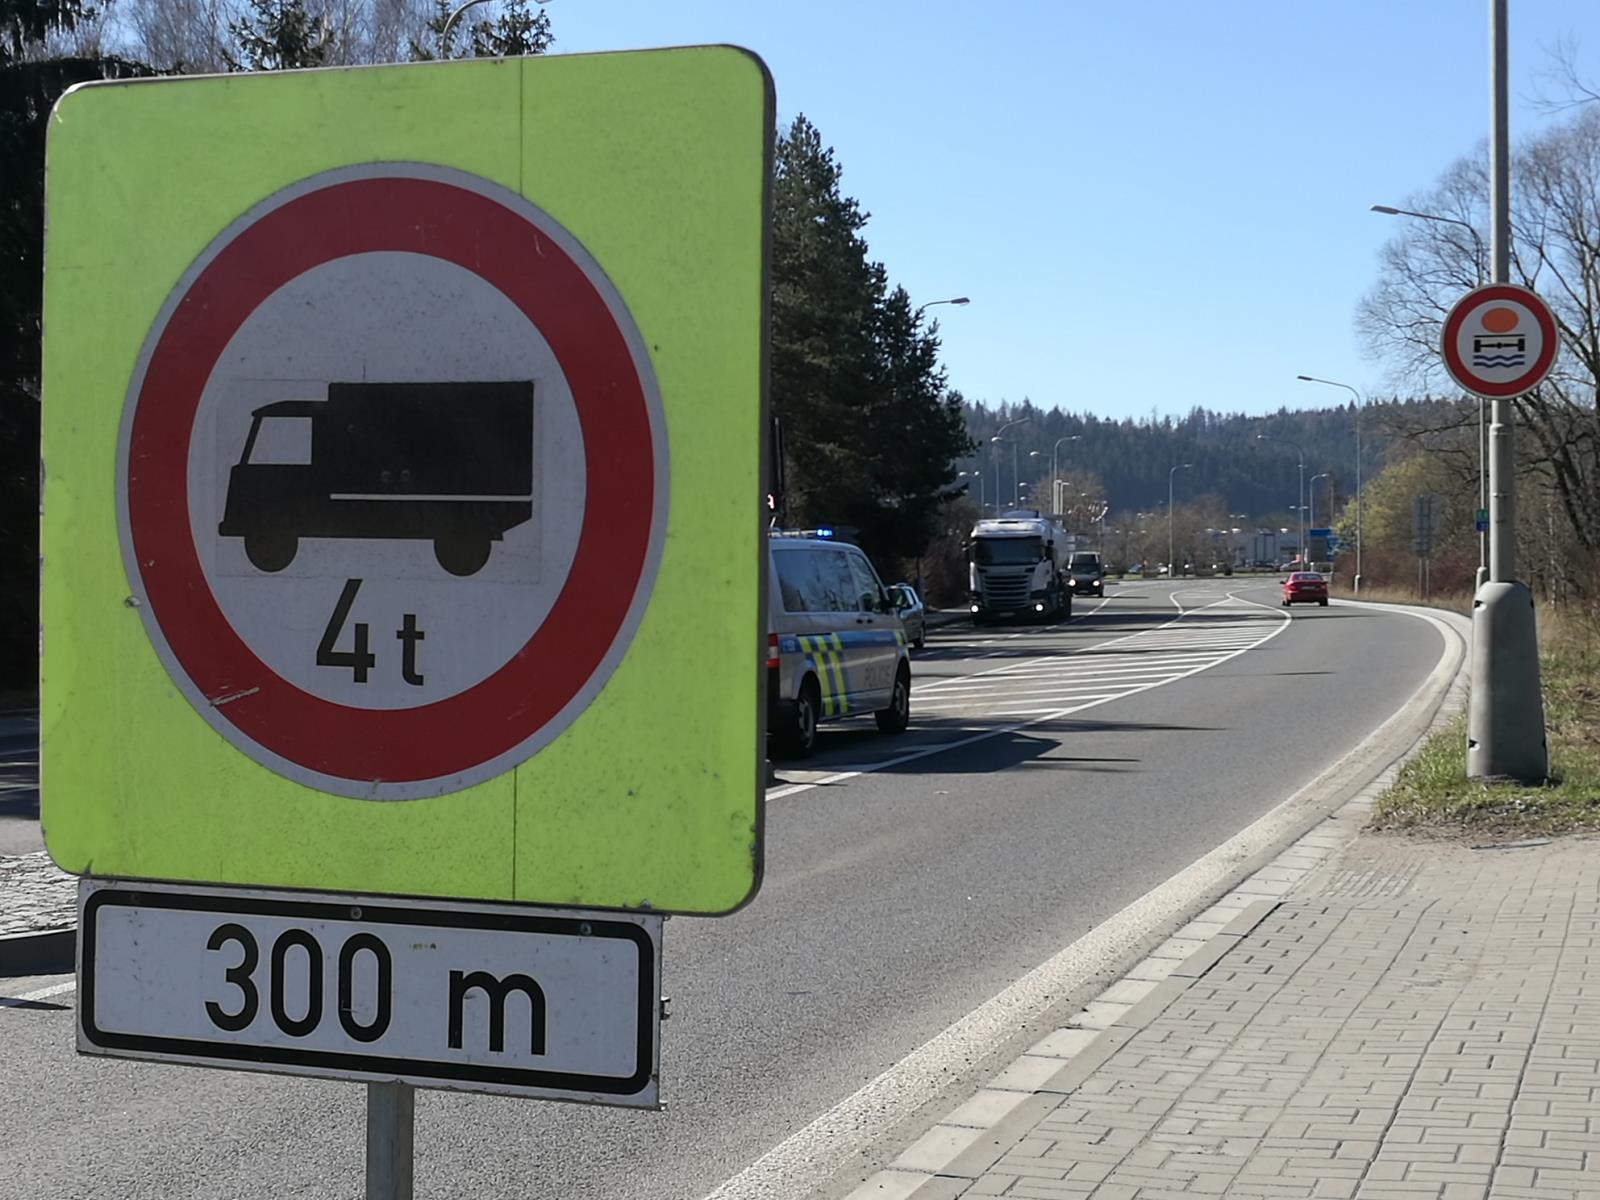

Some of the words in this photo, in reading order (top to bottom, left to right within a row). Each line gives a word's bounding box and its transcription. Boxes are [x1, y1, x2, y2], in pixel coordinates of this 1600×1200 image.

[316, 578, 376, 683] 4
[396, 614, 425, 686] t
[205, 923, 392, 1043] 300
[448, 970, 546, 1056] m
